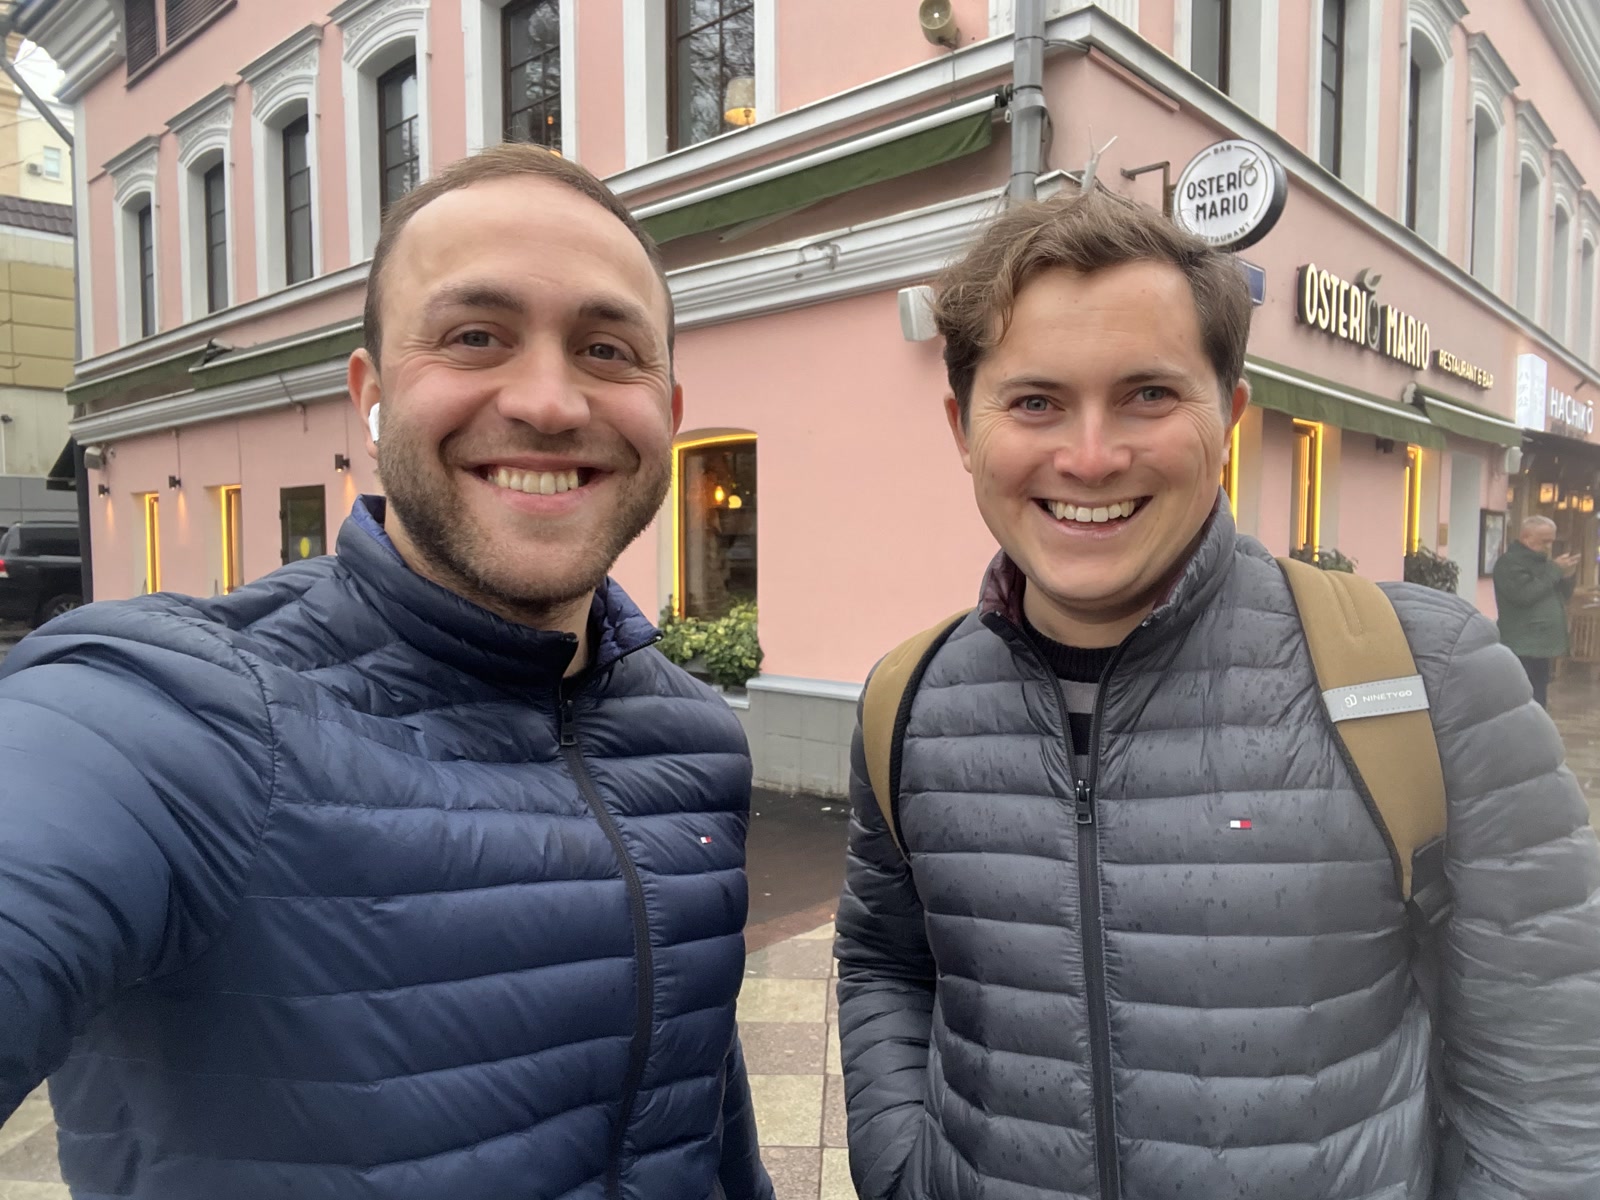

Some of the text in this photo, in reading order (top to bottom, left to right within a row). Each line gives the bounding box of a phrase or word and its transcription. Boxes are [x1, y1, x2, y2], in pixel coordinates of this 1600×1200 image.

[1212, 144, 1232, 155] BAR
[1186, 164, 1258, 201] OSTERIO
[1195, 192, 1249, 220] MARIO
[1386, 304, 1431, 371] MARIO
[1438, 349, 1478, 383] RESTAURANT
[1482, 370, 1494, 389] BAR
[1362, 689, 1413, 703] NINETYGO
